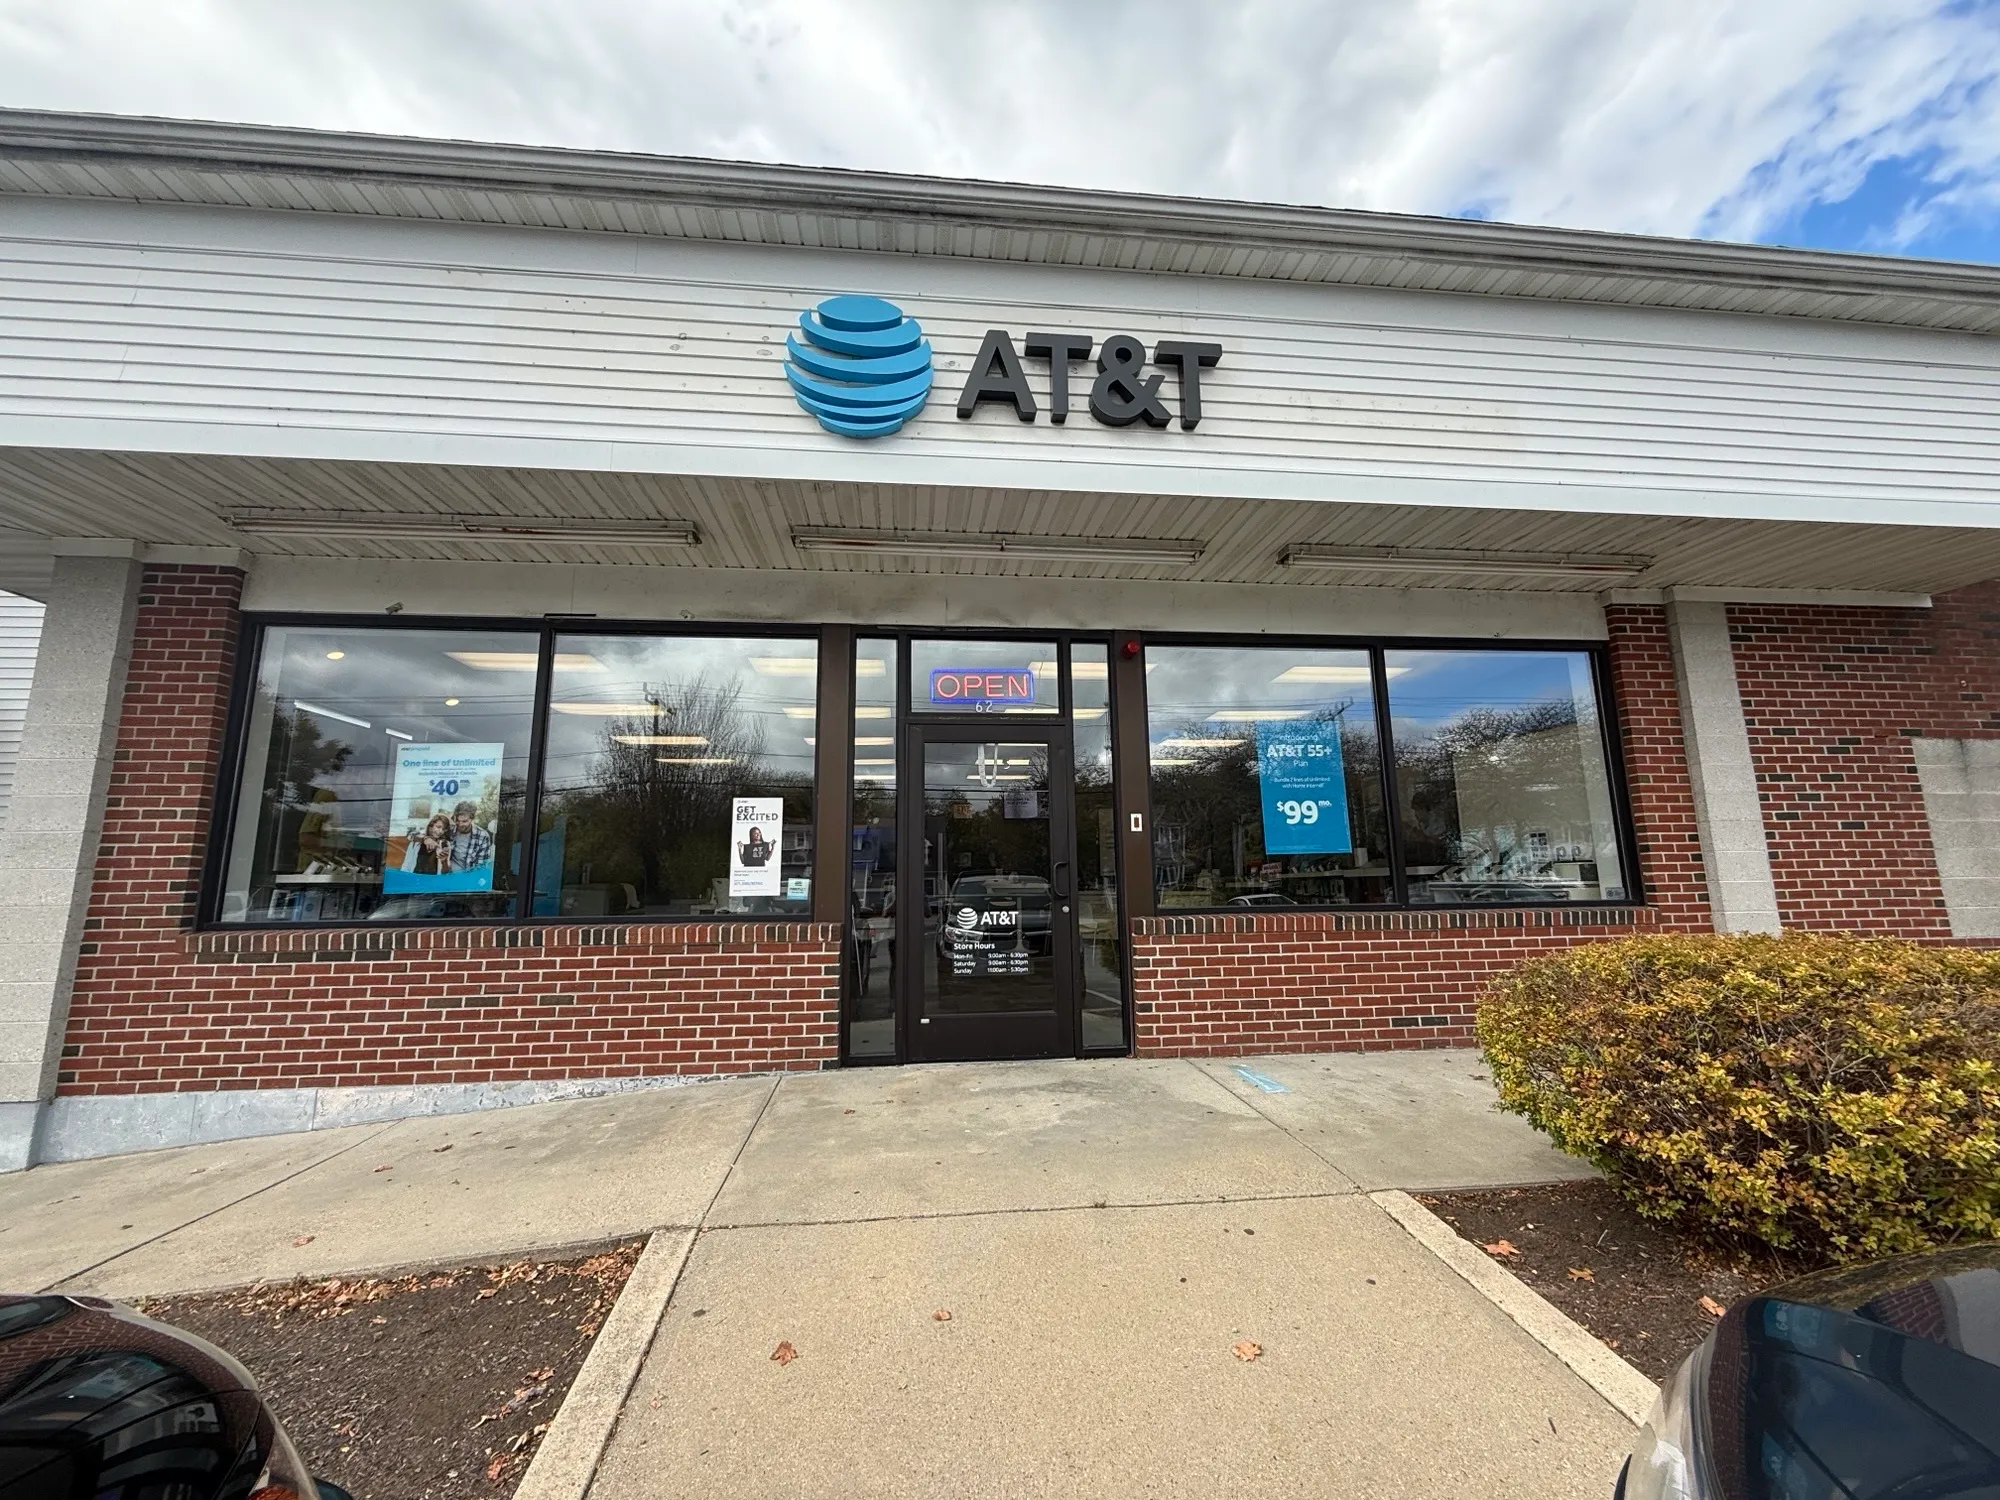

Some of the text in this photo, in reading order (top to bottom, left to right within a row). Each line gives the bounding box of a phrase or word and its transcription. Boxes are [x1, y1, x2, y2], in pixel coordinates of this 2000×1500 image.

[957, 329, 1222, 431] AT&T
[937, 675, 1029, 698] OPEN
[975, 701, 993, 713] 62
[1266, 744, 1333, 757] AT&T 55+
[402, 759, 421, 767] One
[423, 759, 439, 767] line
[453, 758, 496, 767] Unlimited
[1293, 759, 1309, 768] Plan
[429, 779, 459, 796] $40
[736, 805, 757, 814] GET
[1276, 800, 1319, 825] $99
[736, 812, 779, 821] EXCITED
[980, 910, 1019, 926] AT&T
[953, 942, 996, 950] Store Hours
